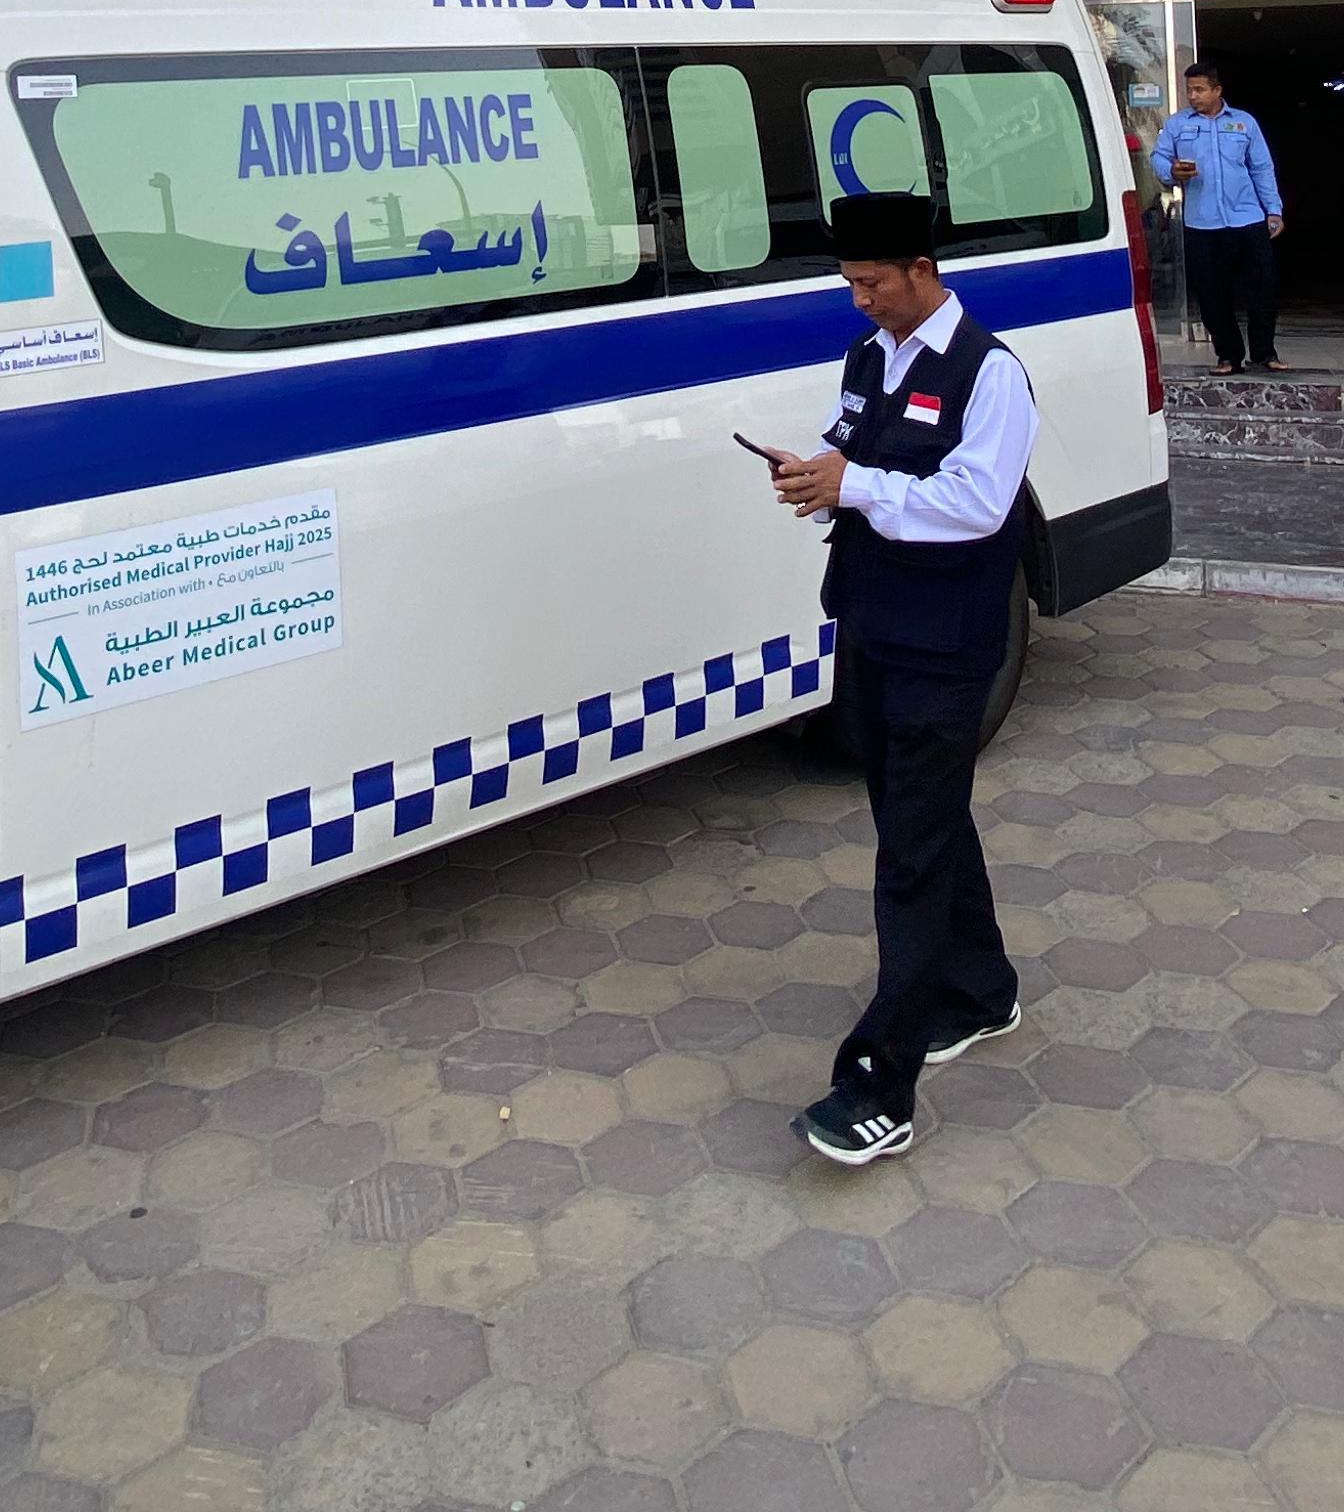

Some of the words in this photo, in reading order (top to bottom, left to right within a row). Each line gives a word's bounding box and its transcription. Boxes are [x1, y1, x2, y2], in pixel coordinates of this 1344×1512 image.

[238, 94, 539, 179] AMBULANCE
[245, 199, 548, 295] إسعاف
[49, 328, 98, 344] إسعاف
[12, 357, 34, 370] Basic
[223, 516, 281, 538] خدمات
[285, 505, 331, 529] مقدم
[177, 530, 220, 550] طبية
[73, 552, 108, 575] لحج
[112, 544, 172, 564] معتمد
[26, 572, 122, 606] Authorised
[127, 557, 189, 584] Medical
[194, 544, 261, 569] Provider
[265, 533, 294, 554] Hajj
[297, 526, 333, 546] 2025
[26, 560, 68, 582] 1446
[237, 560, 285, 581] بالتعاون
[216, 572, 236, 587] مع
[87, 603, 100, 616] In
[102, 587, 176, 609] Association
[179, 578, 205, 594] with
[250, 589, 334, 616] مجموعة
[185, 604, 245, 638] العبير
[105, 620, 178, 655] الطبية
[106, 655, 175, 686] Abeer
[182, 628, 266, 666] Medical
[274, 615, 335, 641] Group
